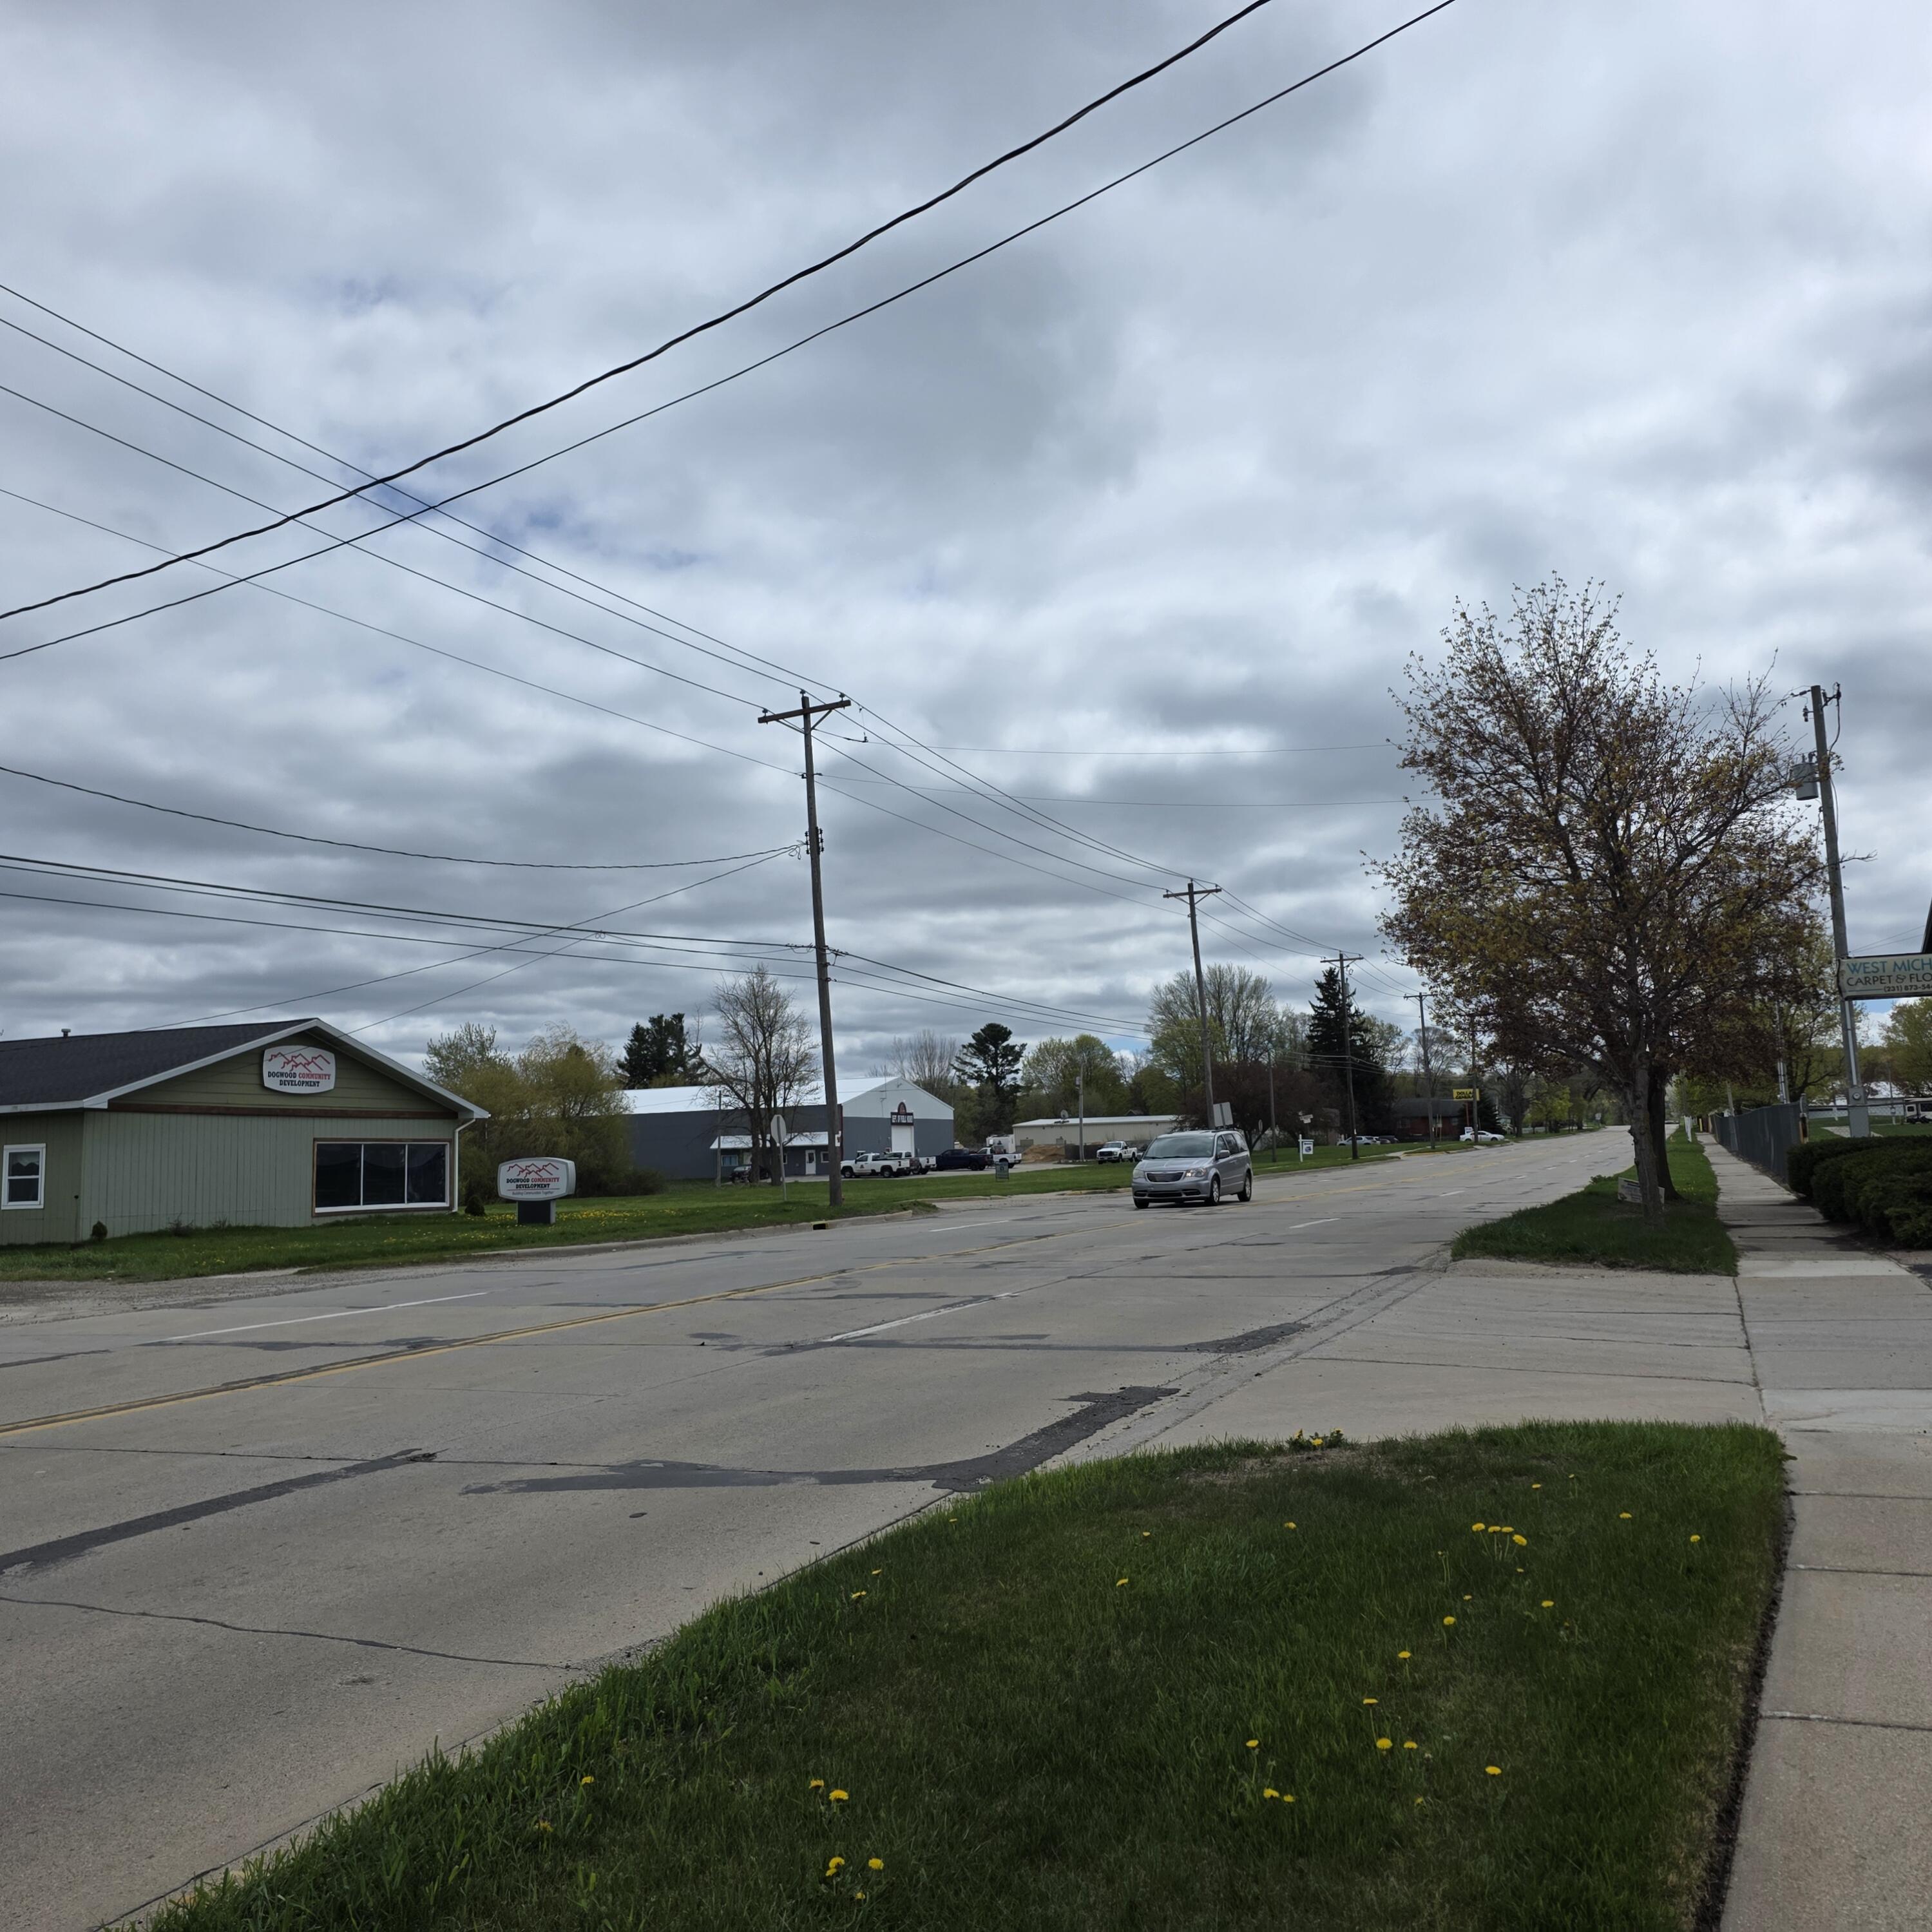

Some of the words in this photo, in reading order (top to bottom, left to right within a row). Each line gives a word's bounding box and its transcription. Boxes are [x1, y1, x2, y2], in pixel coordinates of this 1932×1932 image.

[1847, 961, 1888, 974] WEST
[1893, 958, 1932, 972] MICH
[1846, 975, 1892, 986] CARPET
[1896, 974, 1907, 984] &
[1909, 972, 1932, 983] FLO
